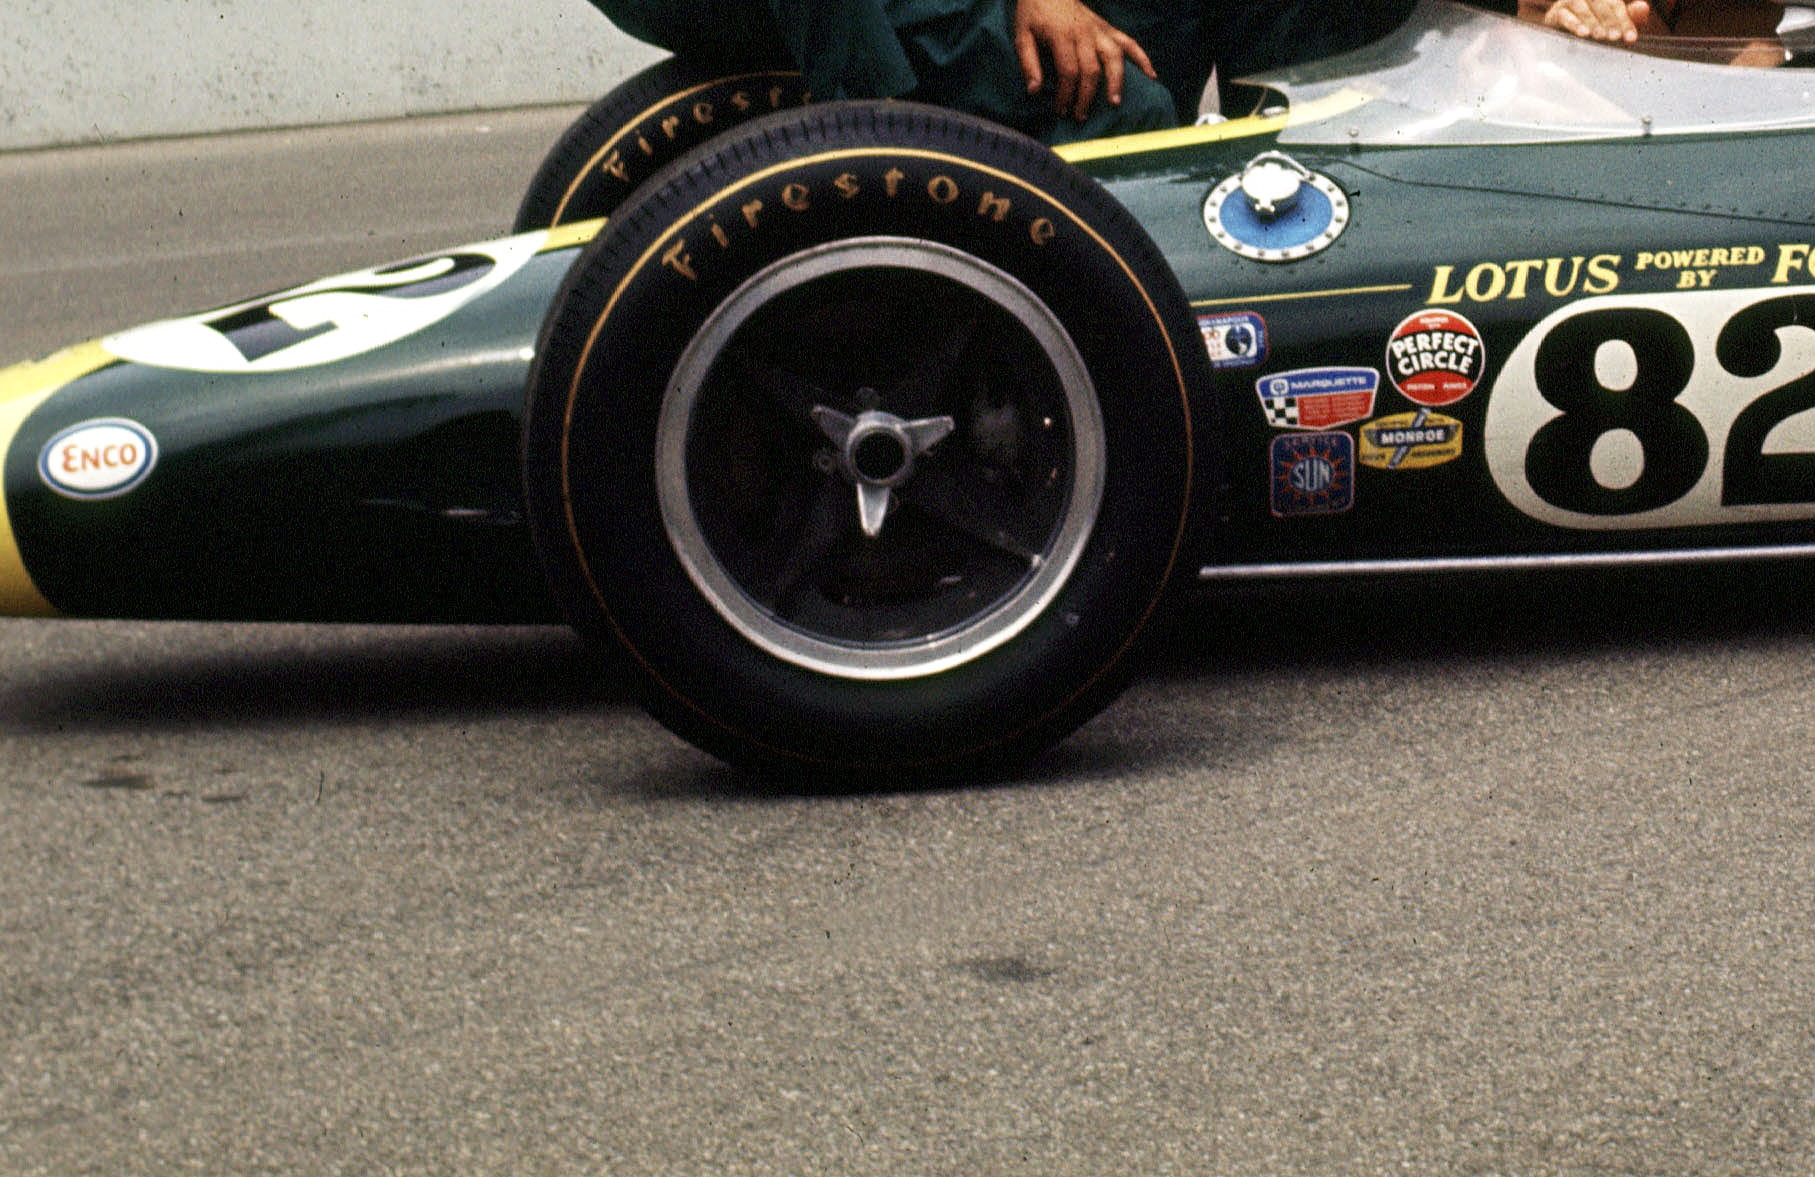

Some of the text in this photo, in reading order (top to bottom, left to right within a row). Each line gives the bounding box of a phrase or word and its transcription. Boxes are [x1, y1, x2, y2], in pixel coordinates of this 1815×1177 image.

[661, 166, 1056, 281] Firestone
[1634, 246, 1766, 270] POWERED
[1425, 254, 1622, 306] LOTUS
[1676, 270, 1718, 289] BY
[1391, 332, 1479, 360] PERFECT
[1398, 351, 1473, 376] CIRCLE
[1290, 376, 1367, 390] MARQUETTE
[1381, 429, 1446, 445] MONROE
[1293, 457, 1331, 492] SUN
